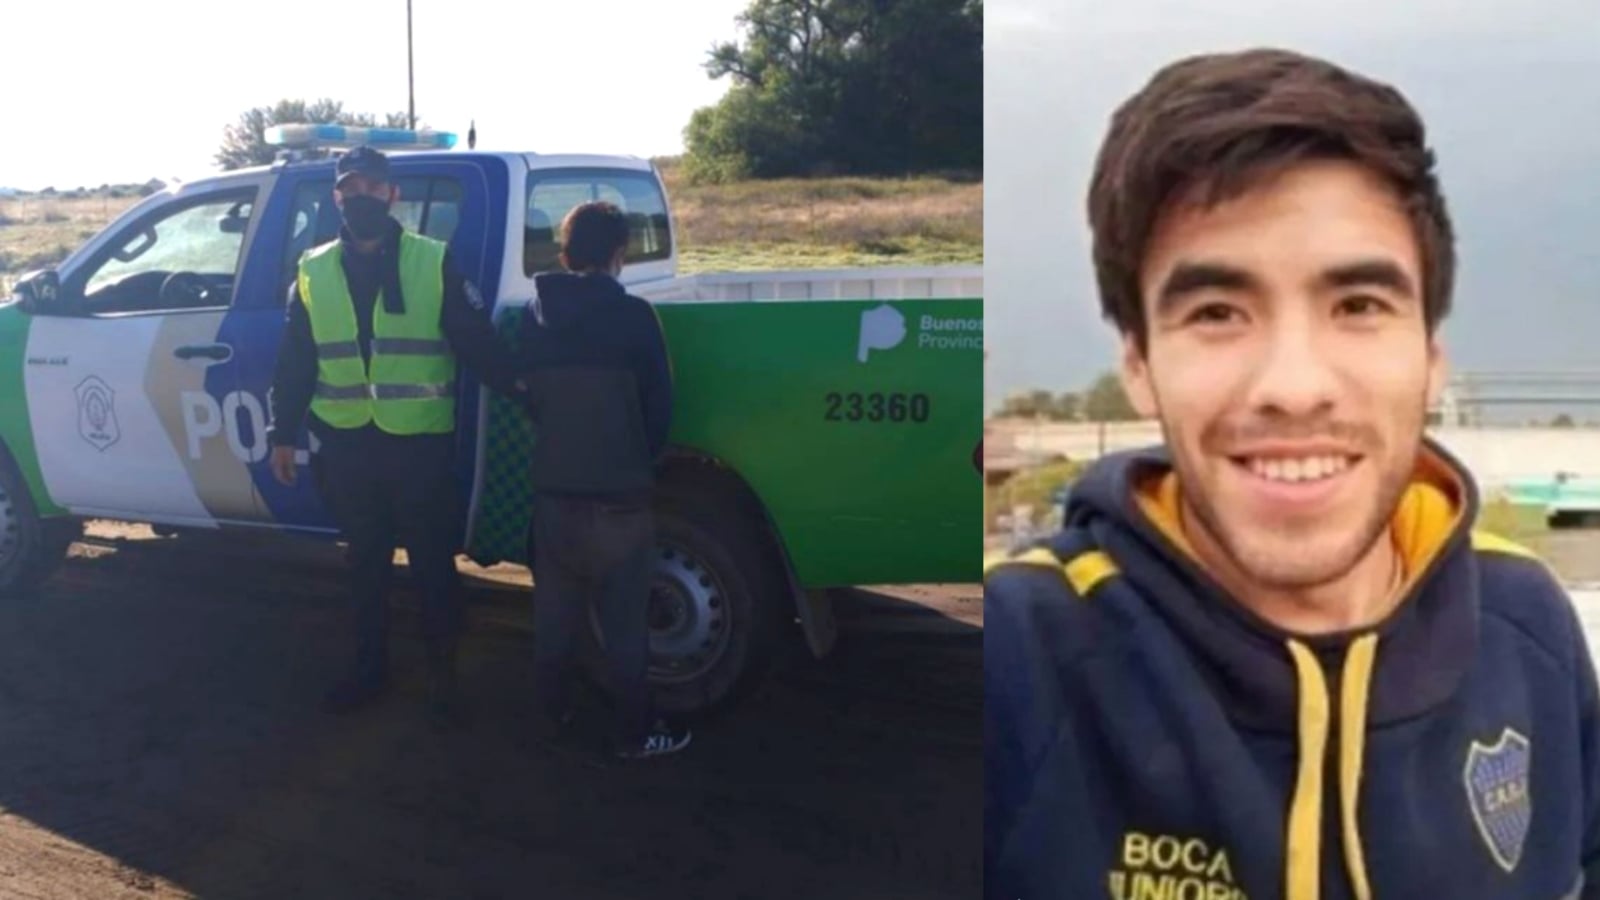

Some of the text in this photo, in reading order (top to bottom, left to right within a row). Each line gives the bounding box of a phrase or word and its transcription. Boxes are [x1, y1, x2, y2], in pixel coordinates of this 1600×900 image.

[181, 389, 309, 465] PO
[824, 392, 930, 423] 23360
[1123, 832, 1234, 883] BOCA
